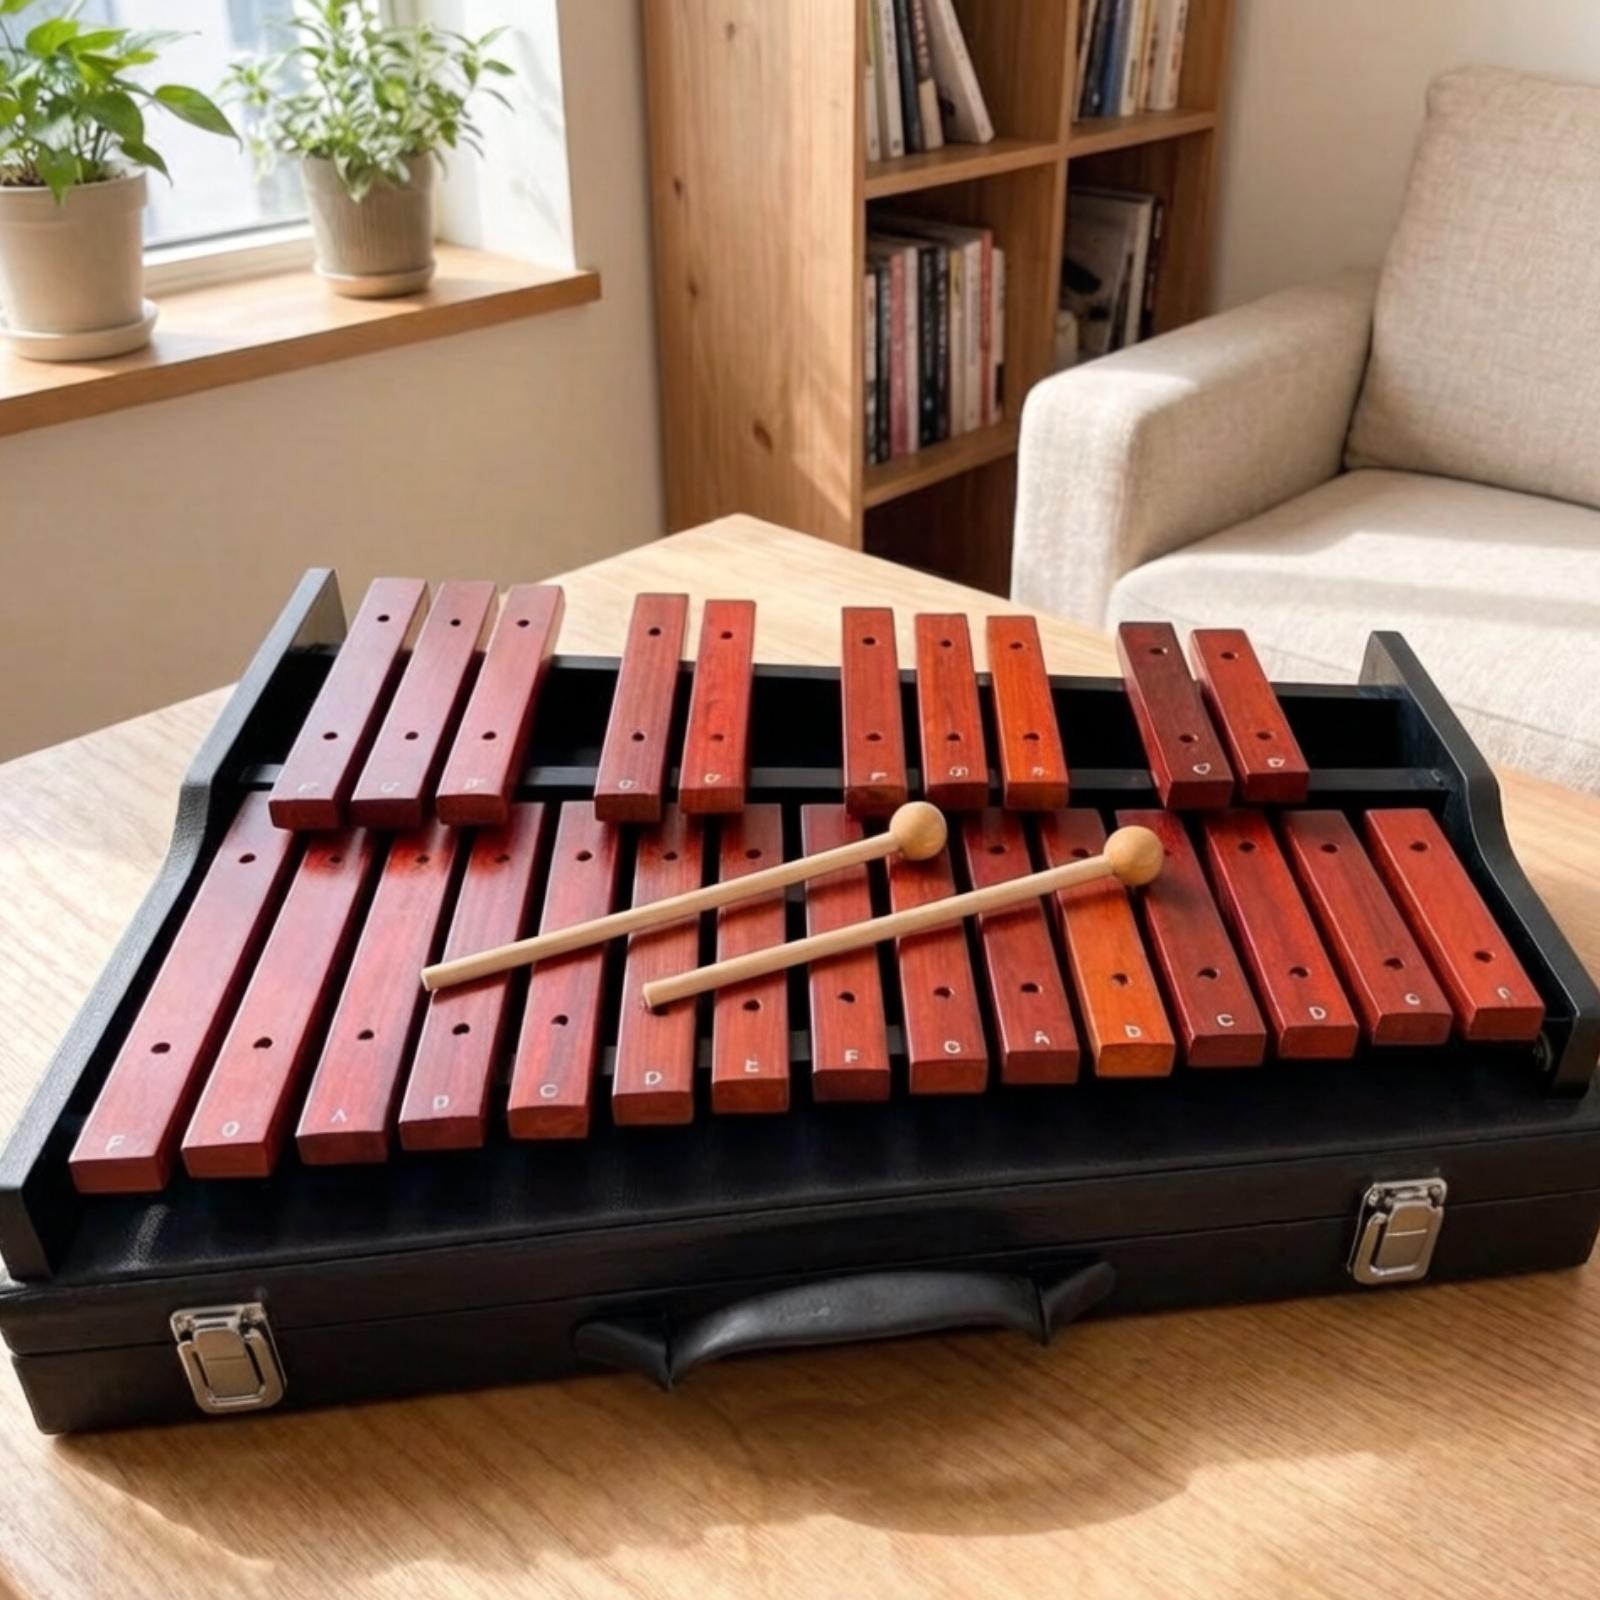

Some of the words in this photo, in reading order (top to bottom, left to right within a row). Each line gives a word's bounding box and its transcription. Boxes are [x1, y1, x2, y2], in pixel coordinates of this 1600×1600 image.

[1217, 1014, 1234, 1027] C
[1309, 1007, 1326, 1020] D
[844, 1049, 859, 1063] F
[745, 1059, 759, 1072] E
[644, 1071, 662, 1086] D
[540, 1084, 558, 1098] C
[105, 1135, 125, 1152] F
